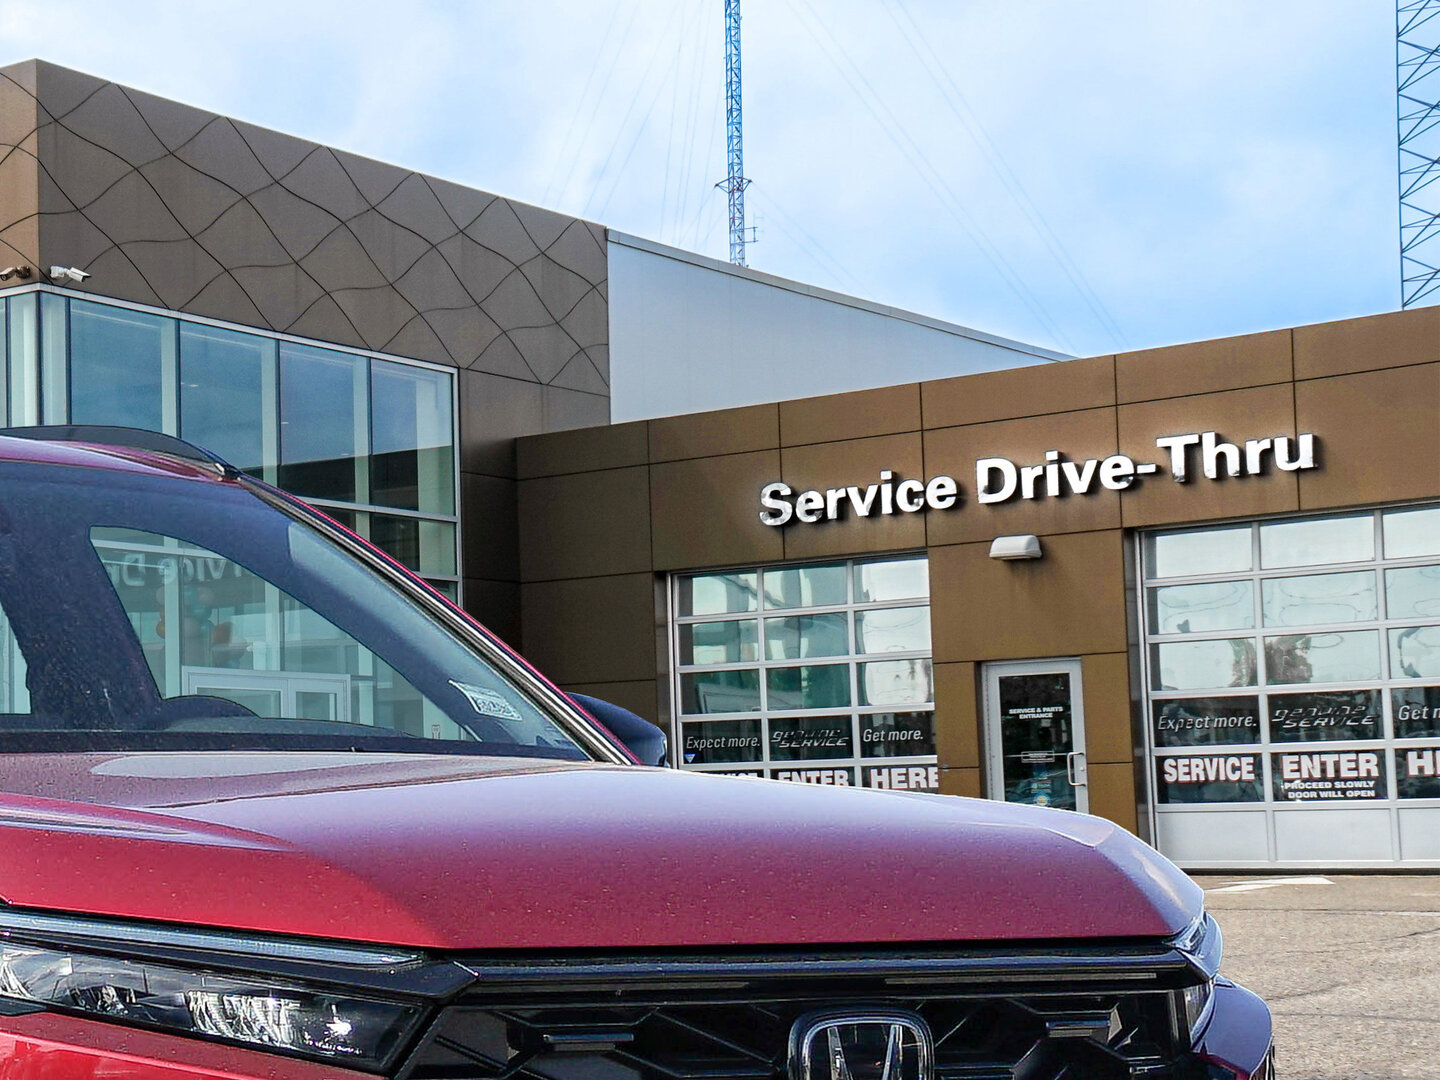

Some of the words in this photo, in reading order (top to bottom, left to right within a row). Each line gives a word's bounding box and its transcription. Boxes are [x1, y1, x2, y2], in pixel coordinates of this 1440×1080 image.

[759, 469, 958, 526] Service
[975, 431, 1315, 504] Drive-Thru
[1271, 705, 1367, 722] genuine
[1398, 705, 1429, 720] Get
[1157, 715, 1210, 732] Expect
[1213, 716, 1257, 728] more.
[1282, 715, 1376, 728] SERVICE
[779, 736, 850, 748] SERVICE
[863, 728, 885, 742] Get
[888, 729, 924, 742] more.
[686, 736, 726, 751] Expect
[727, 737, 761, 748] more.
[1163, 756, 1255, 782] SERVICE
[1282, 752, 1379, 779] ENTER
[778, 769, 850, 786] ENTER
[870, 766, 939, 789] HERE
[1284, 781, 1332, 790] PROCEED
[1334, 780, 1375, 789] SLOWLY
[1288, 791, 1318, 799] DOOR
[1319, 790, 1344, 798] WILL
[1346, 789, 1376, 797] OPEN
